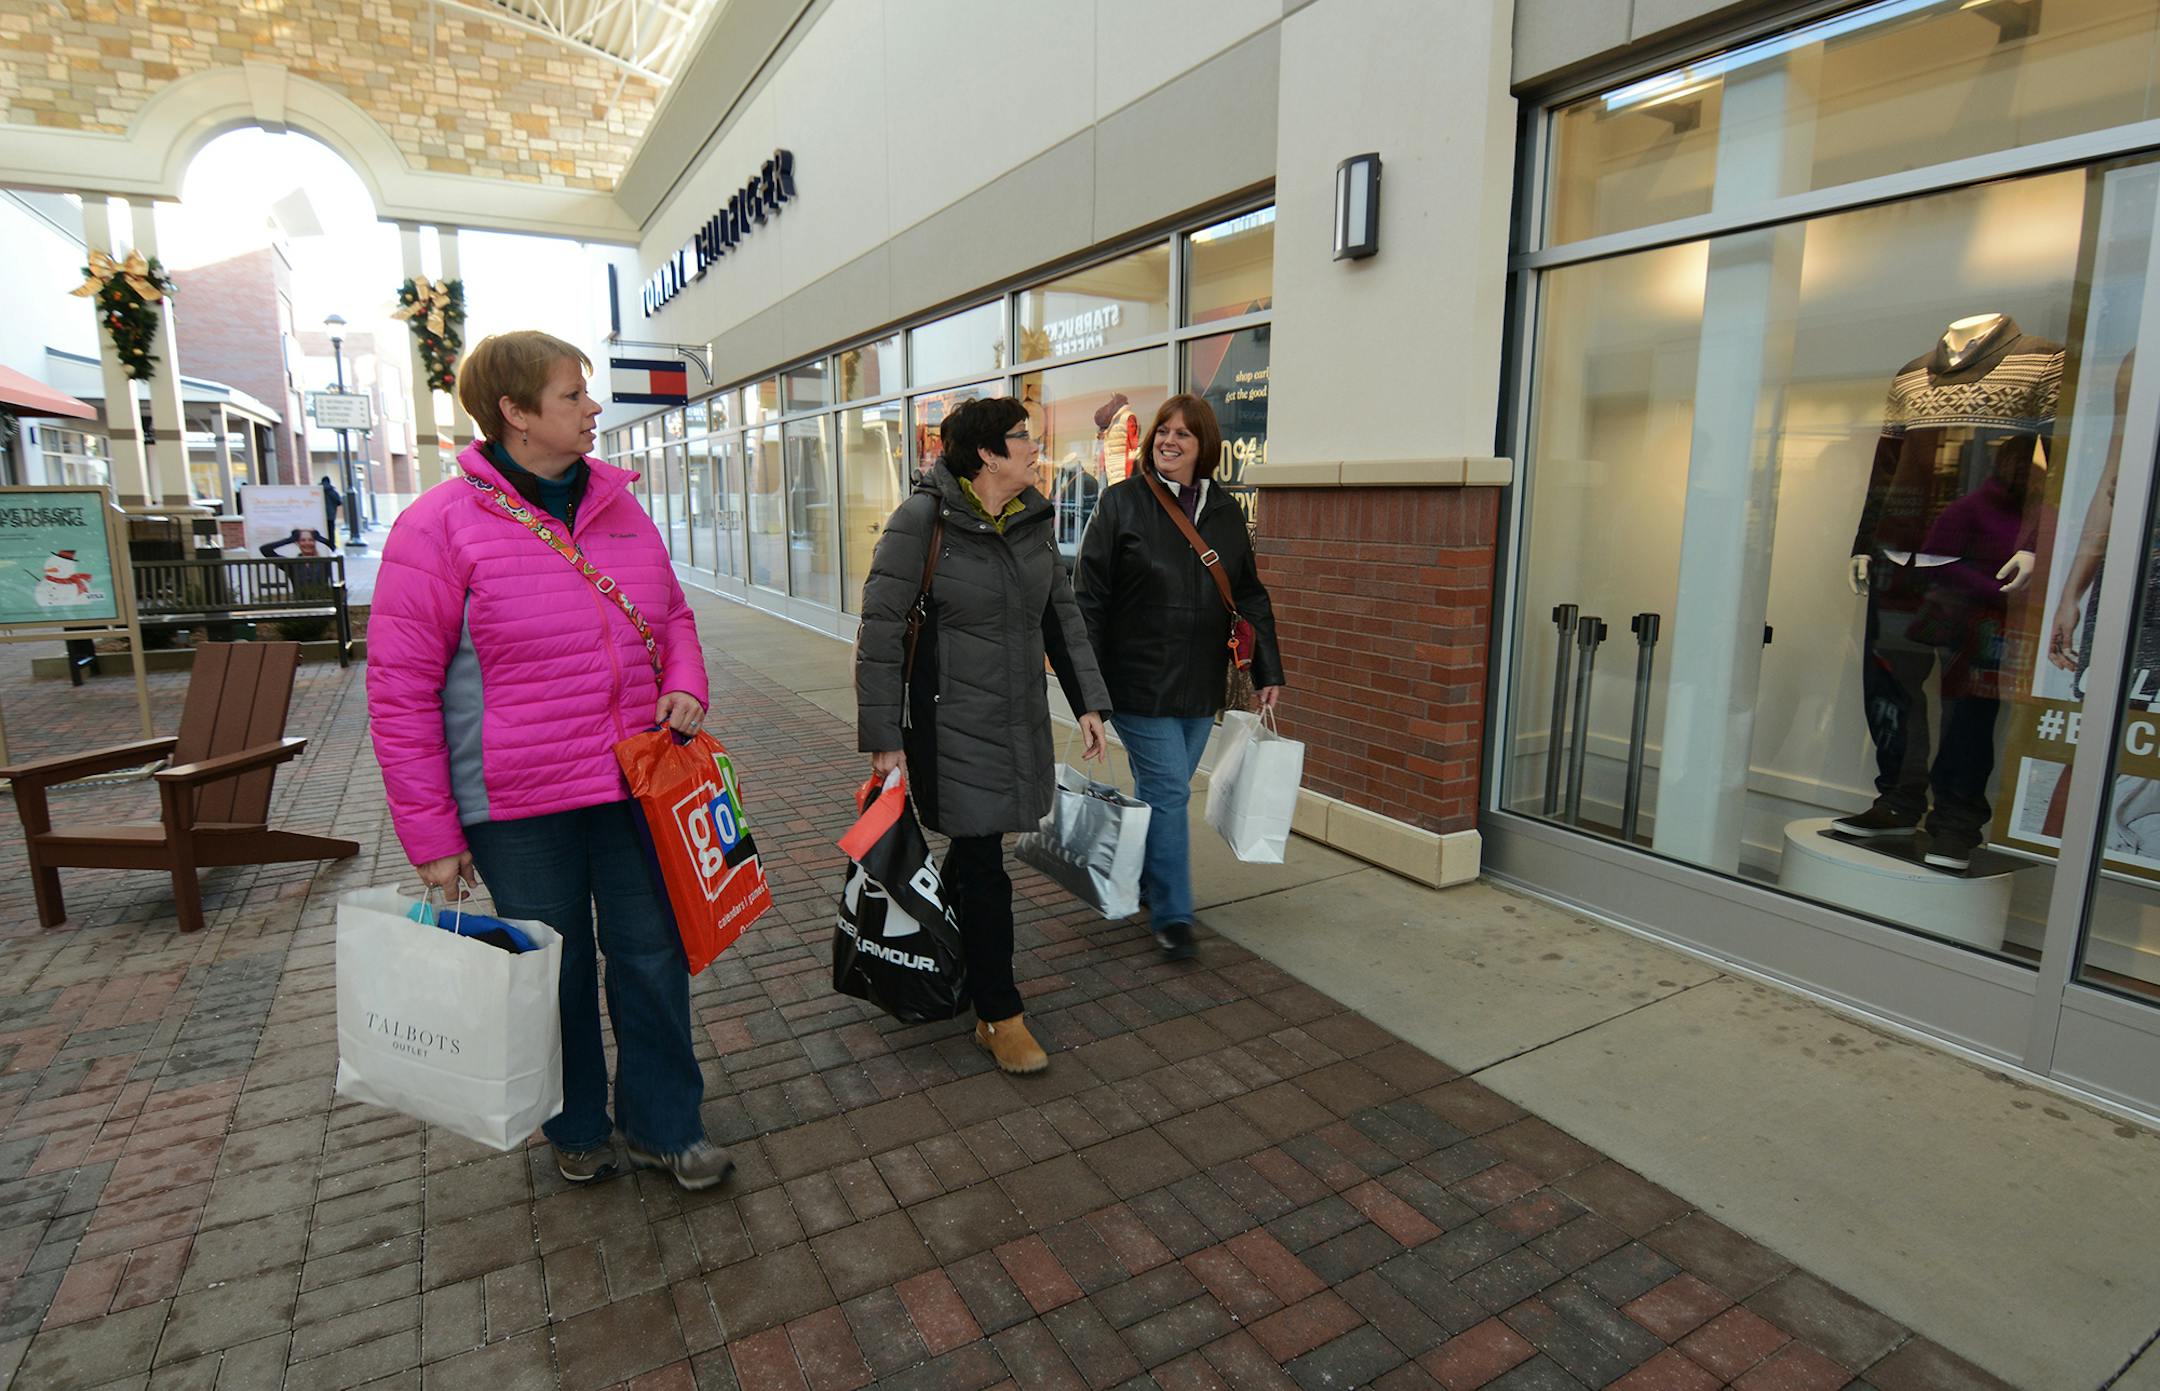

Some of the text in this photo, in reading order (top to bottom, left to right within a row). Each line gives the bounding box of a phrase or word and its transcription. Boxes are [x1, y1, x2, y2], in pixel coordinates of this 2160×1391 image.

[639, 249, 687, 321] TOMMY
[1235, 370, 1253, 383] shop
[1225, 385, 1267, 404] get the good
[21, 508, 49, 519] THE
[51, 507, 83, 519] GIFT
[366, 1011, 461, 1055] TALBOTS
[392, 1040, 428, 1057] OUTLET
